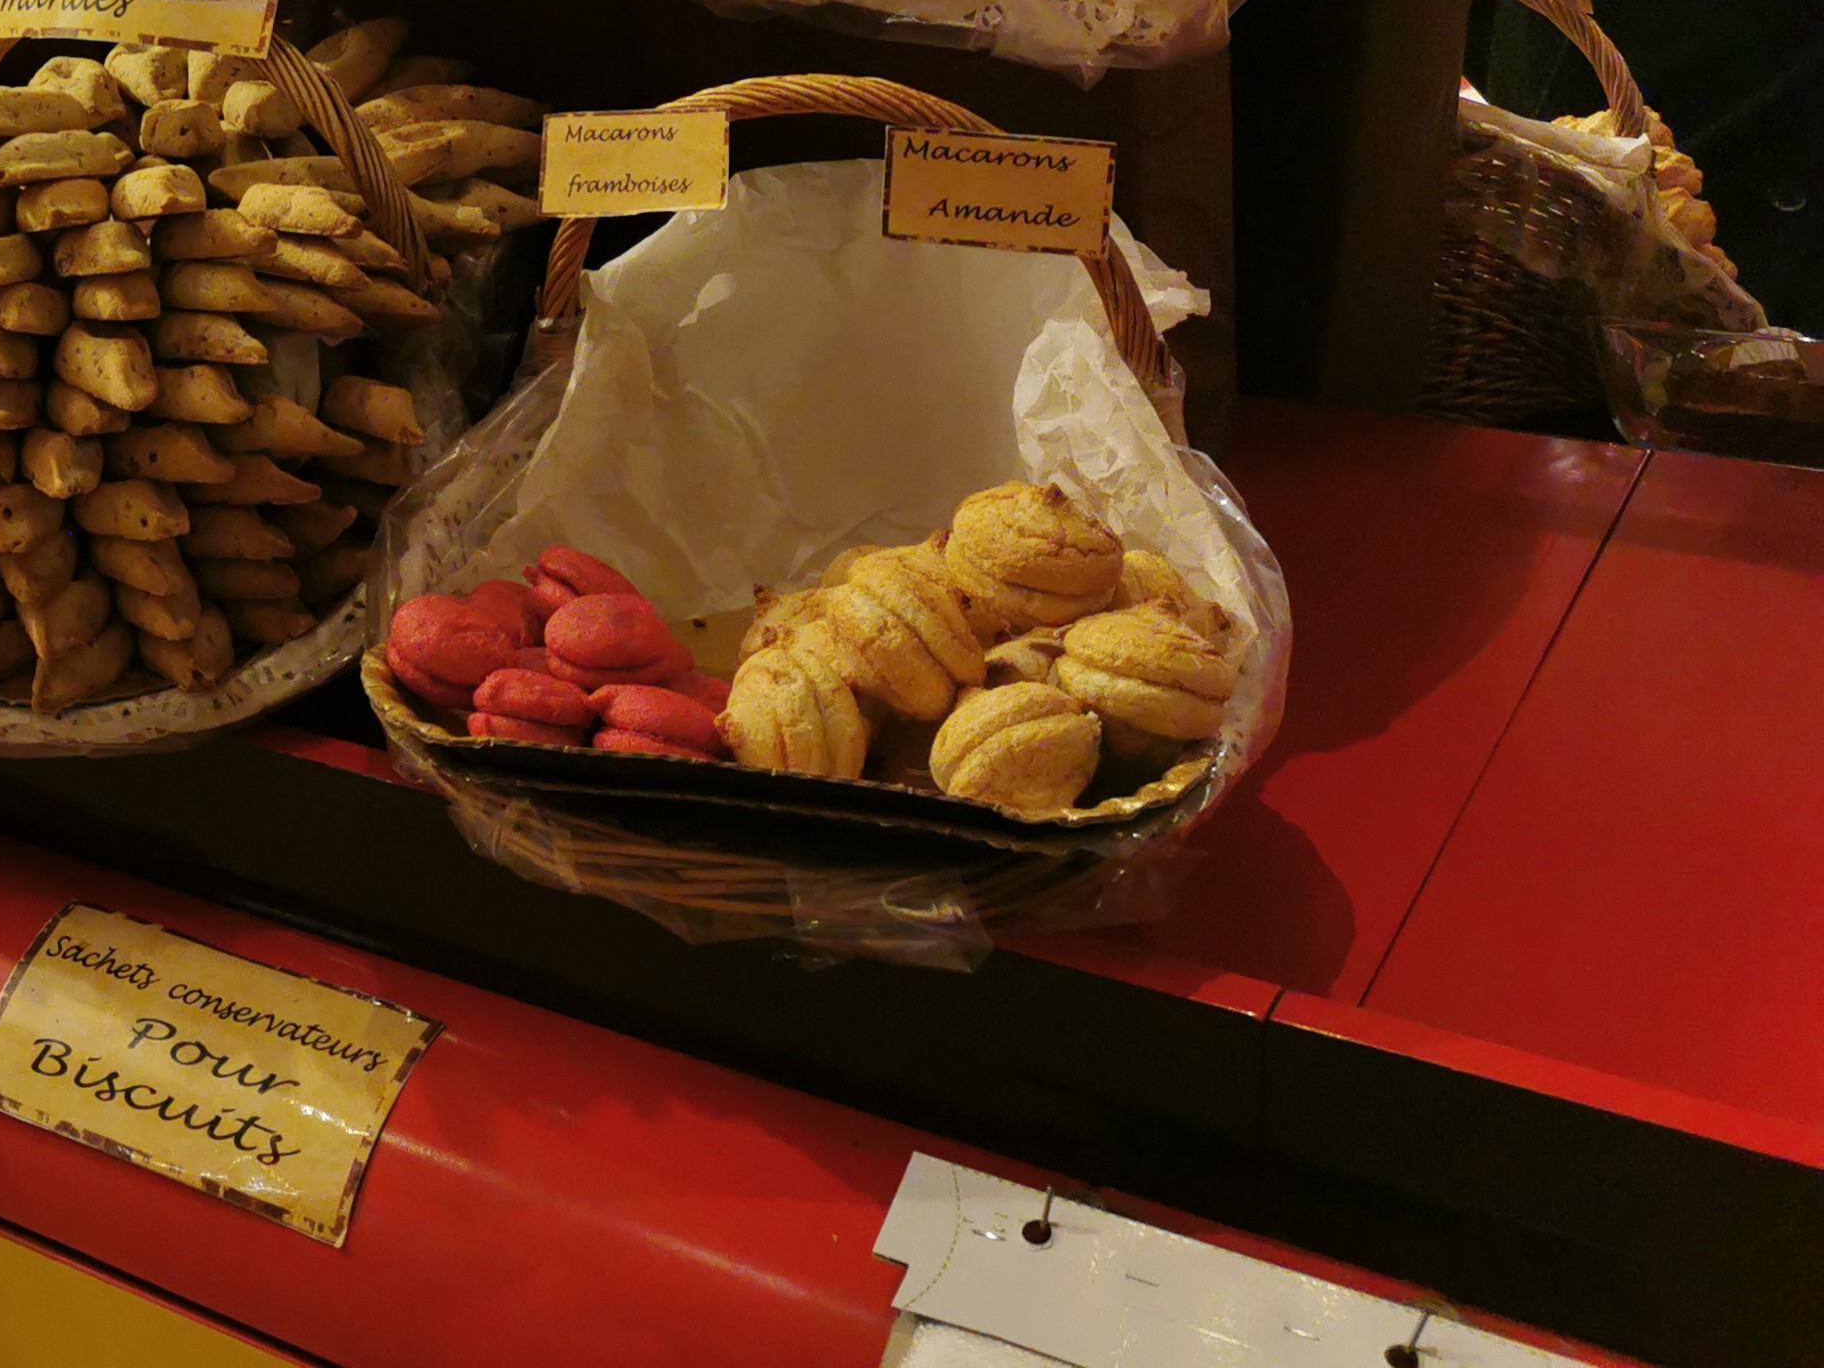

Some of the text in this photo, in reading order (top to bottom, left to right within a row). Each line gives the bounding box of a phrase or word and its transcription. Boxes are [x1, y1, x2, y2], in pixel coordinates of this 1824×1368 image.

[564, 123, 680, 145] Macarons
[902, 136, 1079, 174] Macarons
[565, 172, 695, 199] framboises
[927, 197, 1083, 230] Amande
[45, 935, 390, 1072] Sachets conservateurs
[127, 1017, 302, 1096] Pour
[30, 1037, 302, 1167] Biscuits
